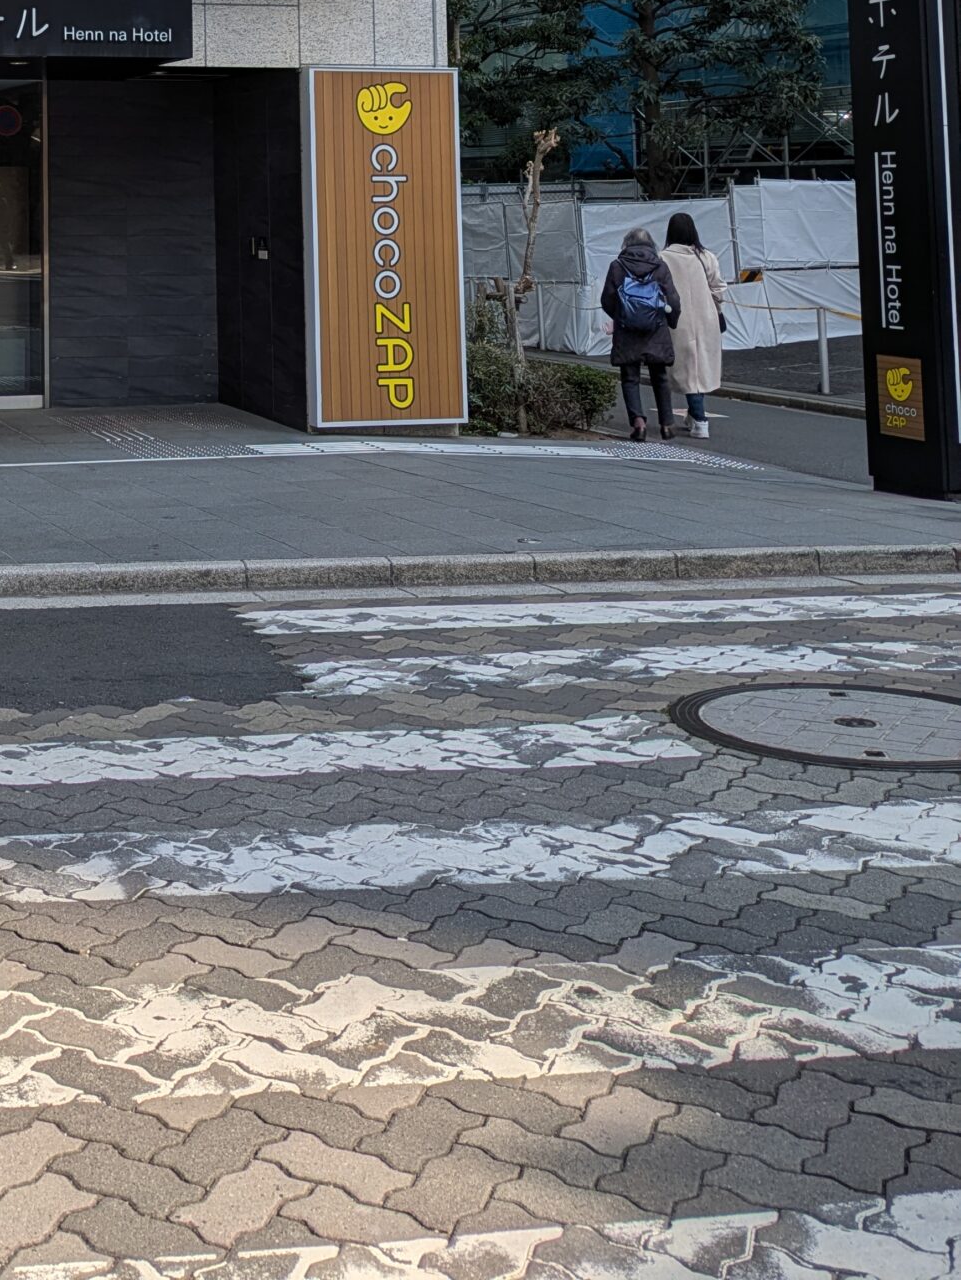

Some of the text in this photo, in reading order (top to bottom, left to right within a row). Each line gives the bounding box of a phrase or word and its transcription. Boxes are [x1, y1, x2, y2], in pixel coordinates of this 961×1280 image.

[63, 25, 172, 43] Henn na Hotel
[881, 151, 904, 330] Henn na Hotel
[370, 142, 415, 410] chocoZAP
[885, 402, 917, 417] choco
[886, 415, 907, 429] ZAP
